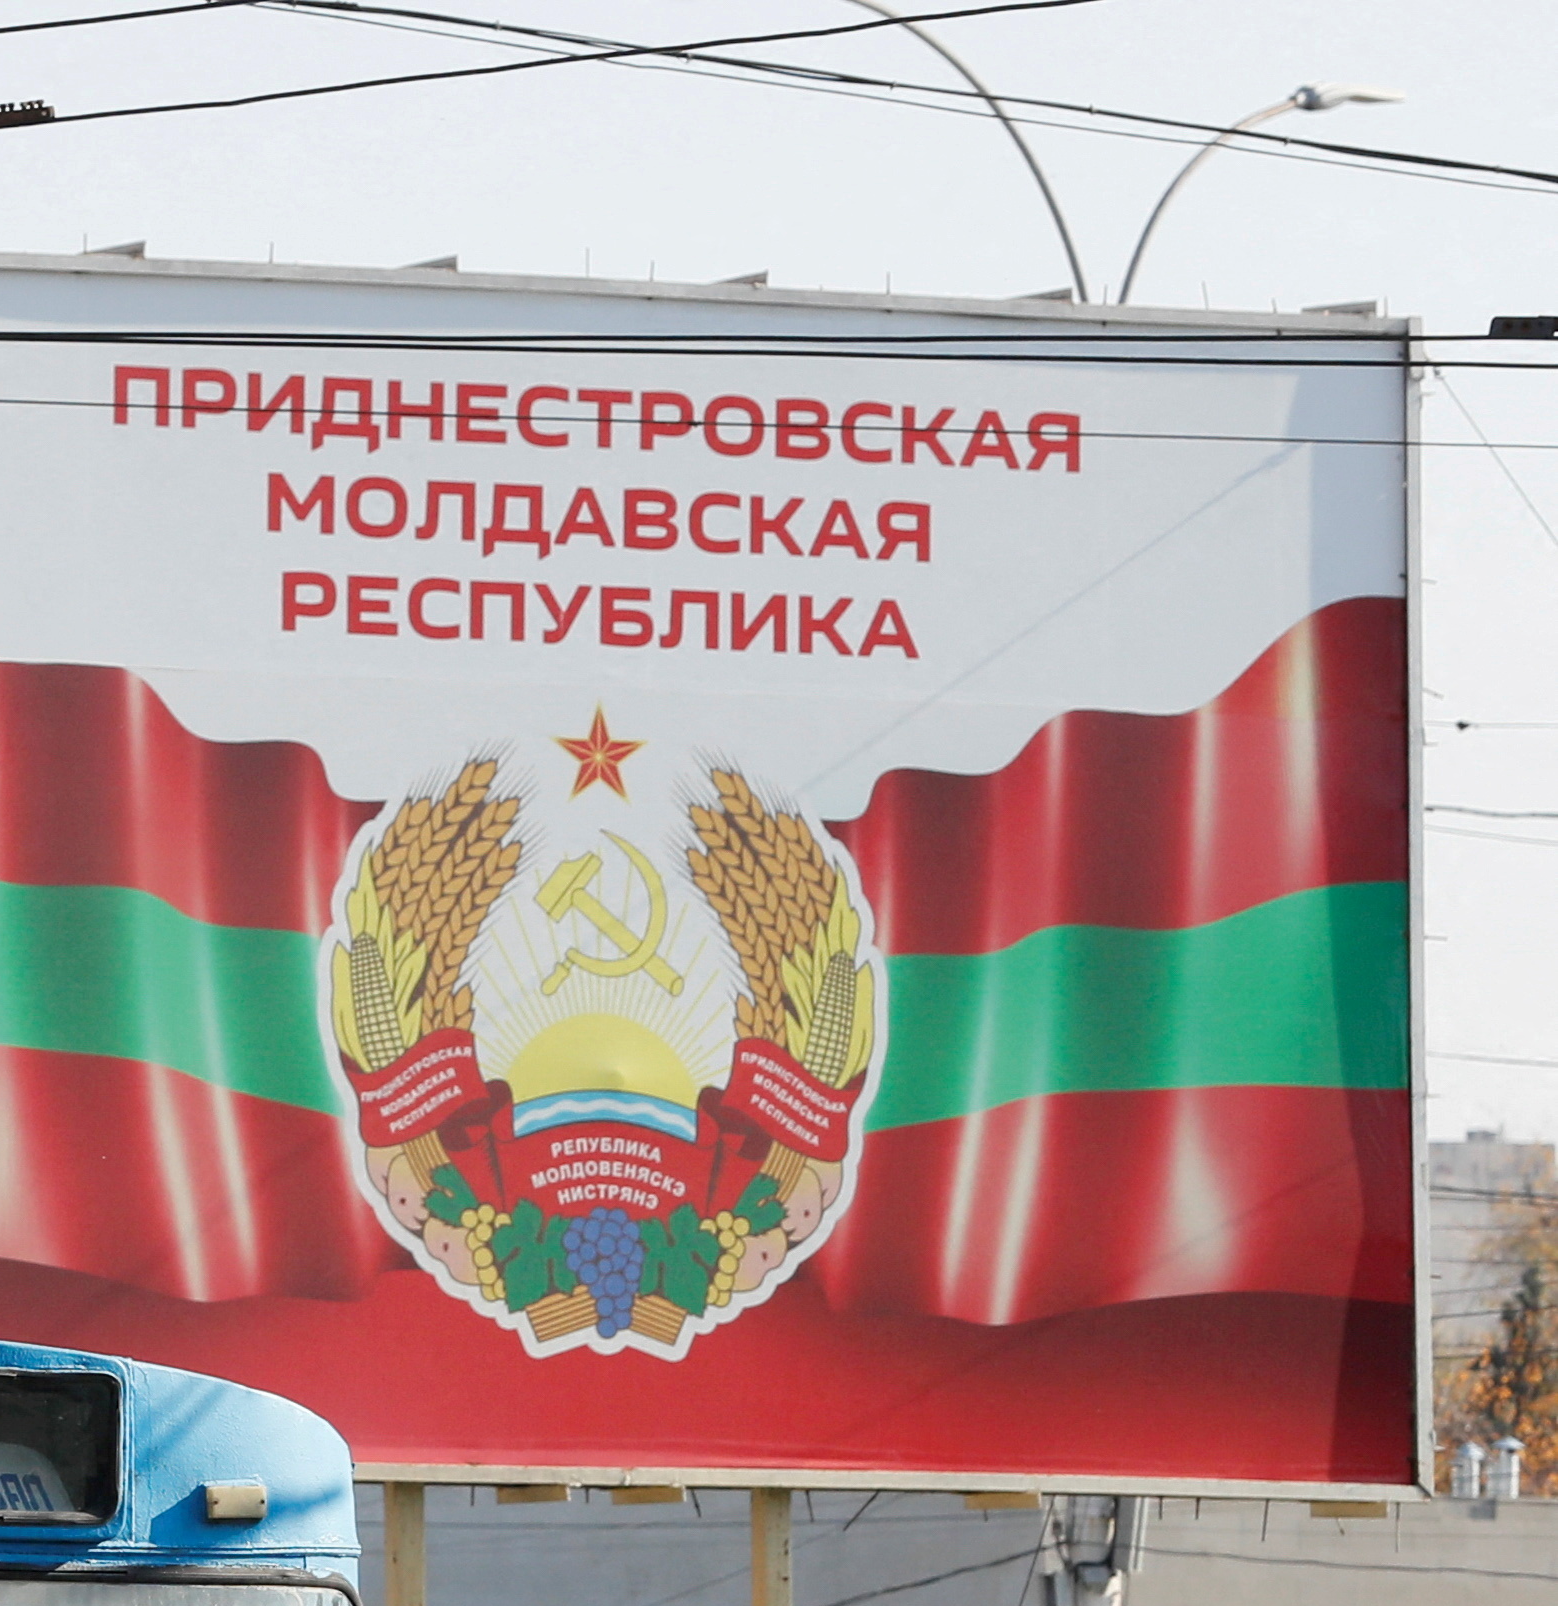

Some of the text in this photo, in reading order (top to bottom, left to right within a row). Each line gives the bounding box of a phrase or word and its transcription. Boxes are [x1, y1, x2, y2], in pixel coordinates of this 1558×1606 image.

[112, 364, 1082, 474] ПРИДНЕСТРОВСКАЯ
[266, 471, 932, 563] МОЛДАВСКАЯ
[280, 571, 921, 660] РЕСПУБЛИКА
[361, 1046, 472, 1102] ПРИДНЕСТРОВСКАЯ
[380, 1067, 456, 1117] МОЛДАВСКАЯ
[389, 1085, 462, 1133] РЕСПУБЛИКА
[753, 1073, 830, 1129] МОЛДАВСЬКА
[550, 1136, 662, 1163] РЕПУБЛИКА
[531, 1160, 686, 1198] МОЛДОВЕНЯСКЭ
[557, 1184, 660, 1210] НИСТРЯНЭ
